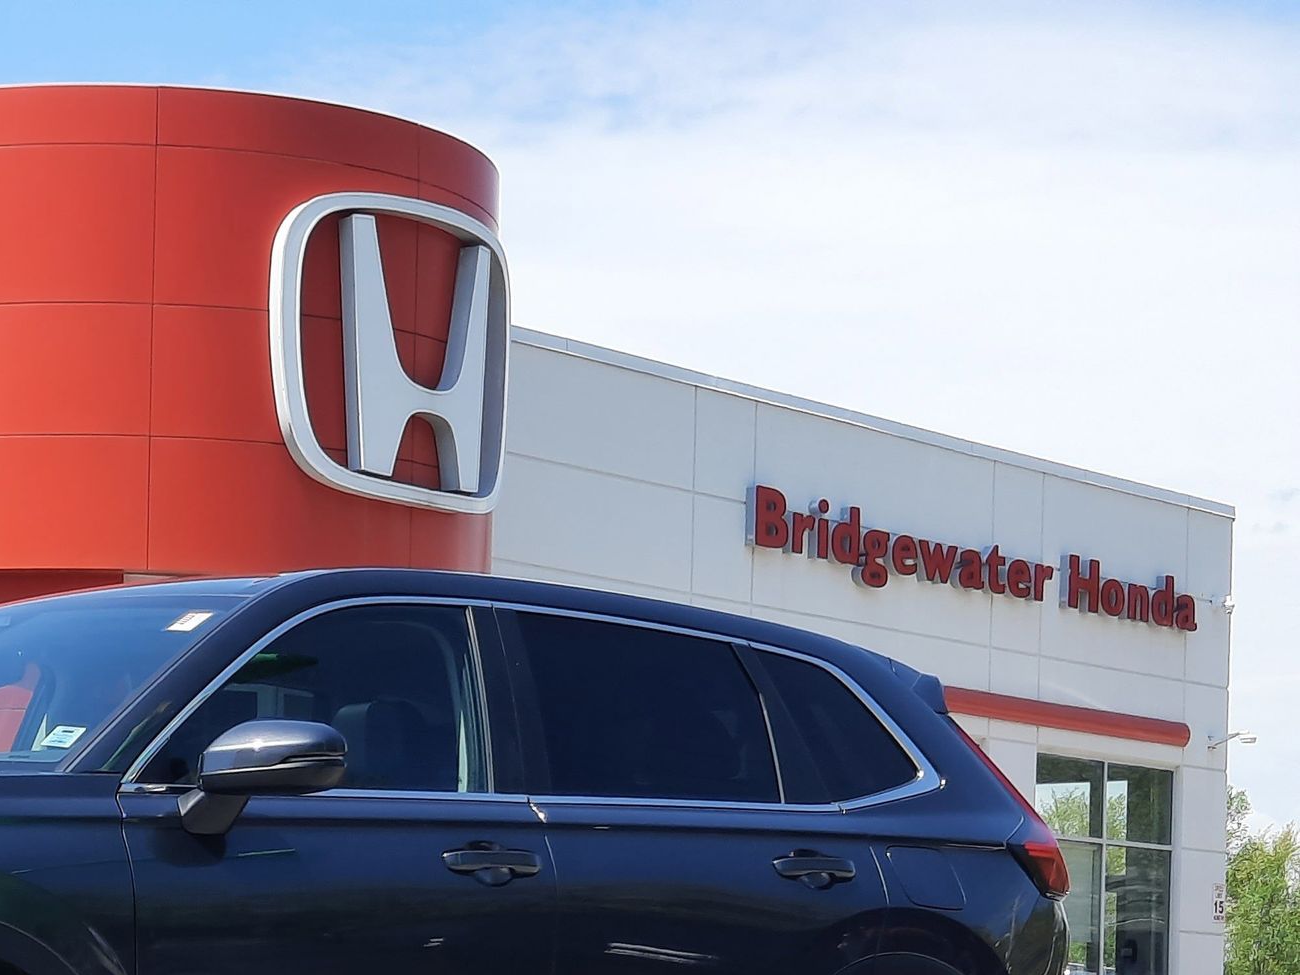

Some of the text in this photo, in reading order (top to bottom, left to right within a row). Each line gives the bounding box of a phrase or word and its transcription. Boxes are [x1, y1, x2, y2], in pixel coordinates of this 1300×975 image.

[753, 484, 1198, 632] Bridgewater Honda
[1214, 900, 1224, 914] 15
